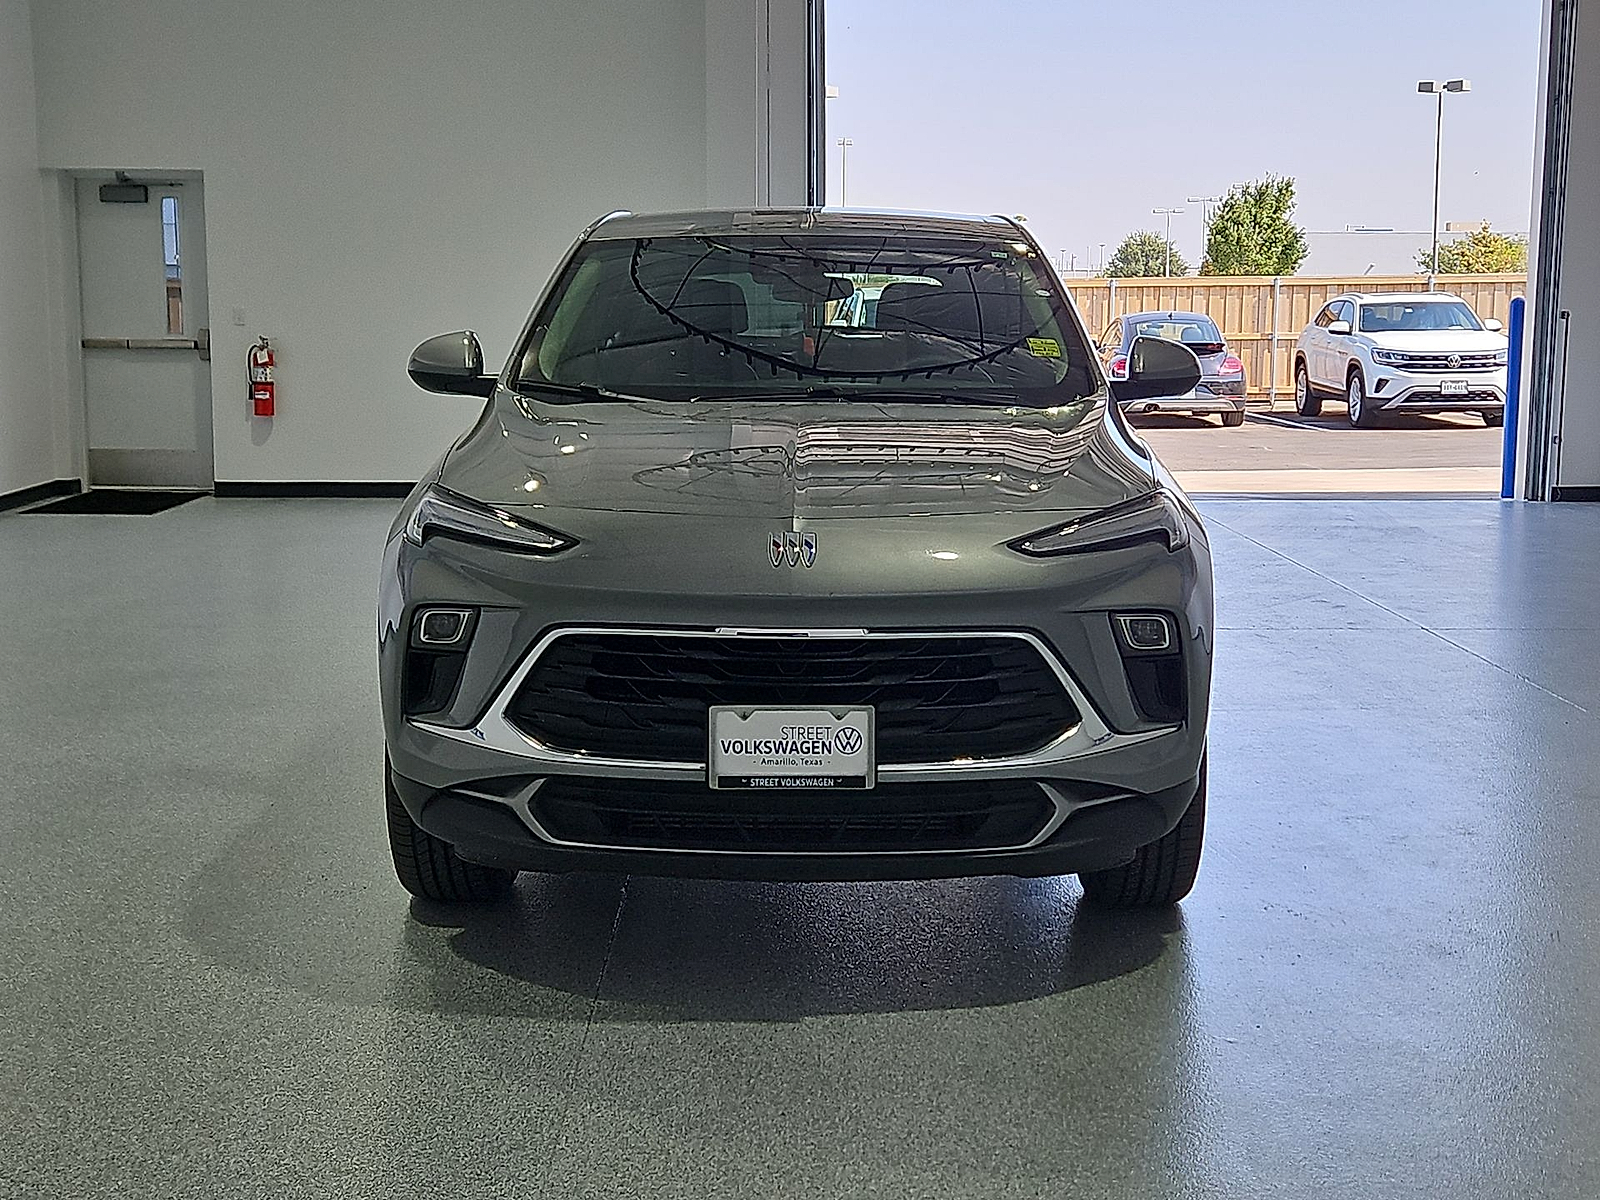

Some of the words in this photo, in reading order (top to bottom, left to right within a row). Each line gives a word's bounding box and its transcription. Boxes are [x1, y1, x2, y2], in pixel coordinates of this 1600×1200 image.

[781, 727, 832, 740] STREET
[721, 740, 832, 754] VOLKSWAGEN
[761, 758, 798, 766] Amarillo,
[800, 758, 823, 766] Texas
[750, 778, 779, 786] STREET
[781, 778, 834, 786] VOLKSWAGEN
